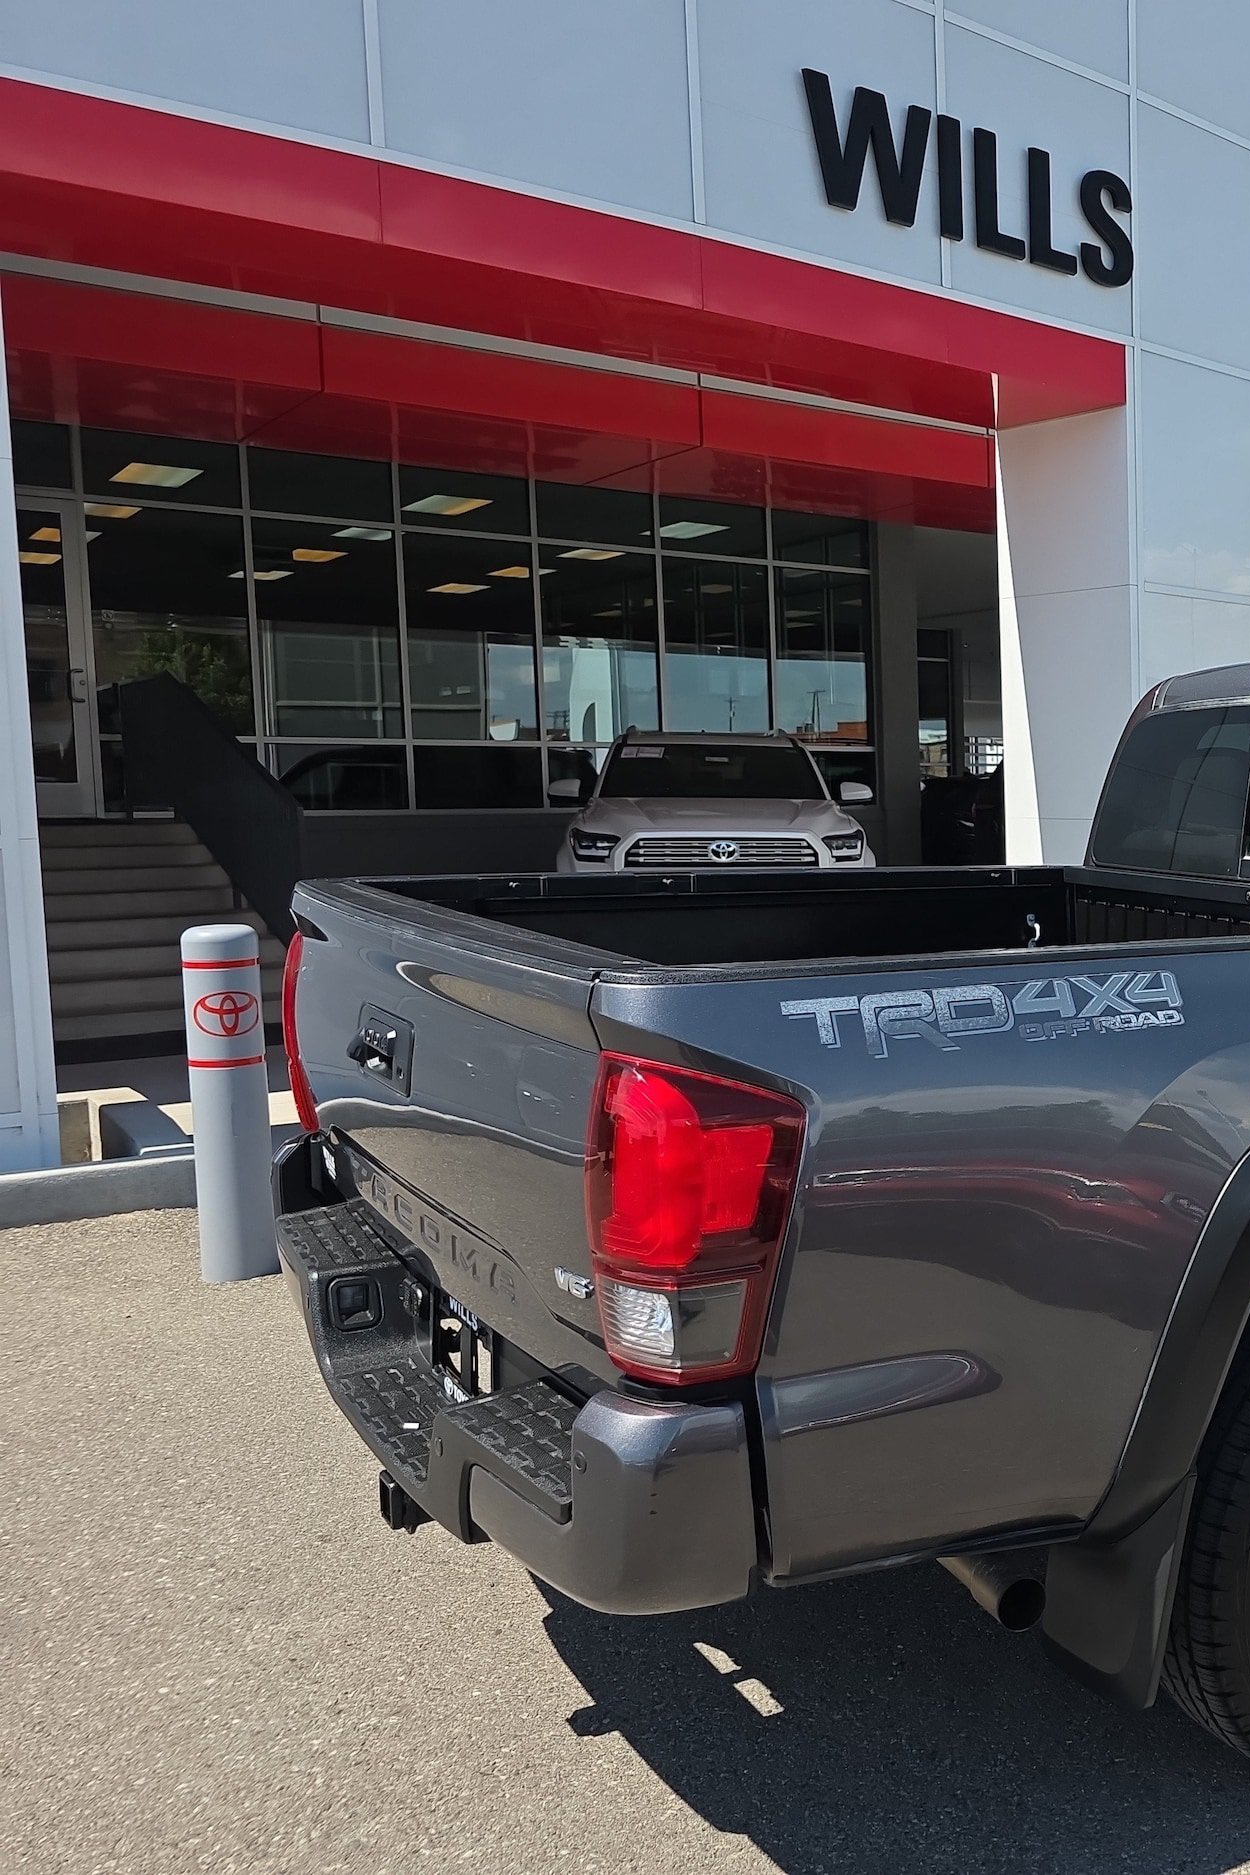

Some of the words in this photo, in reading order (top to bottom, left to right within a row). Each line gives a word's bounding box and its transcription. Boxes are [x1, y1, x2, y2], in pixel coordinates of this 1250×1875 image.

[801, 67, 1134, 288] WILLS
[779, 983, 1015, 1059] TRD
[1018, 1018, 1090, 1042] OFF
[1092, 1009, 1186, 1034] ROAD
[554, 1266, 594, 1299] V6
[448, 1296, 479, 1332] WILLS
